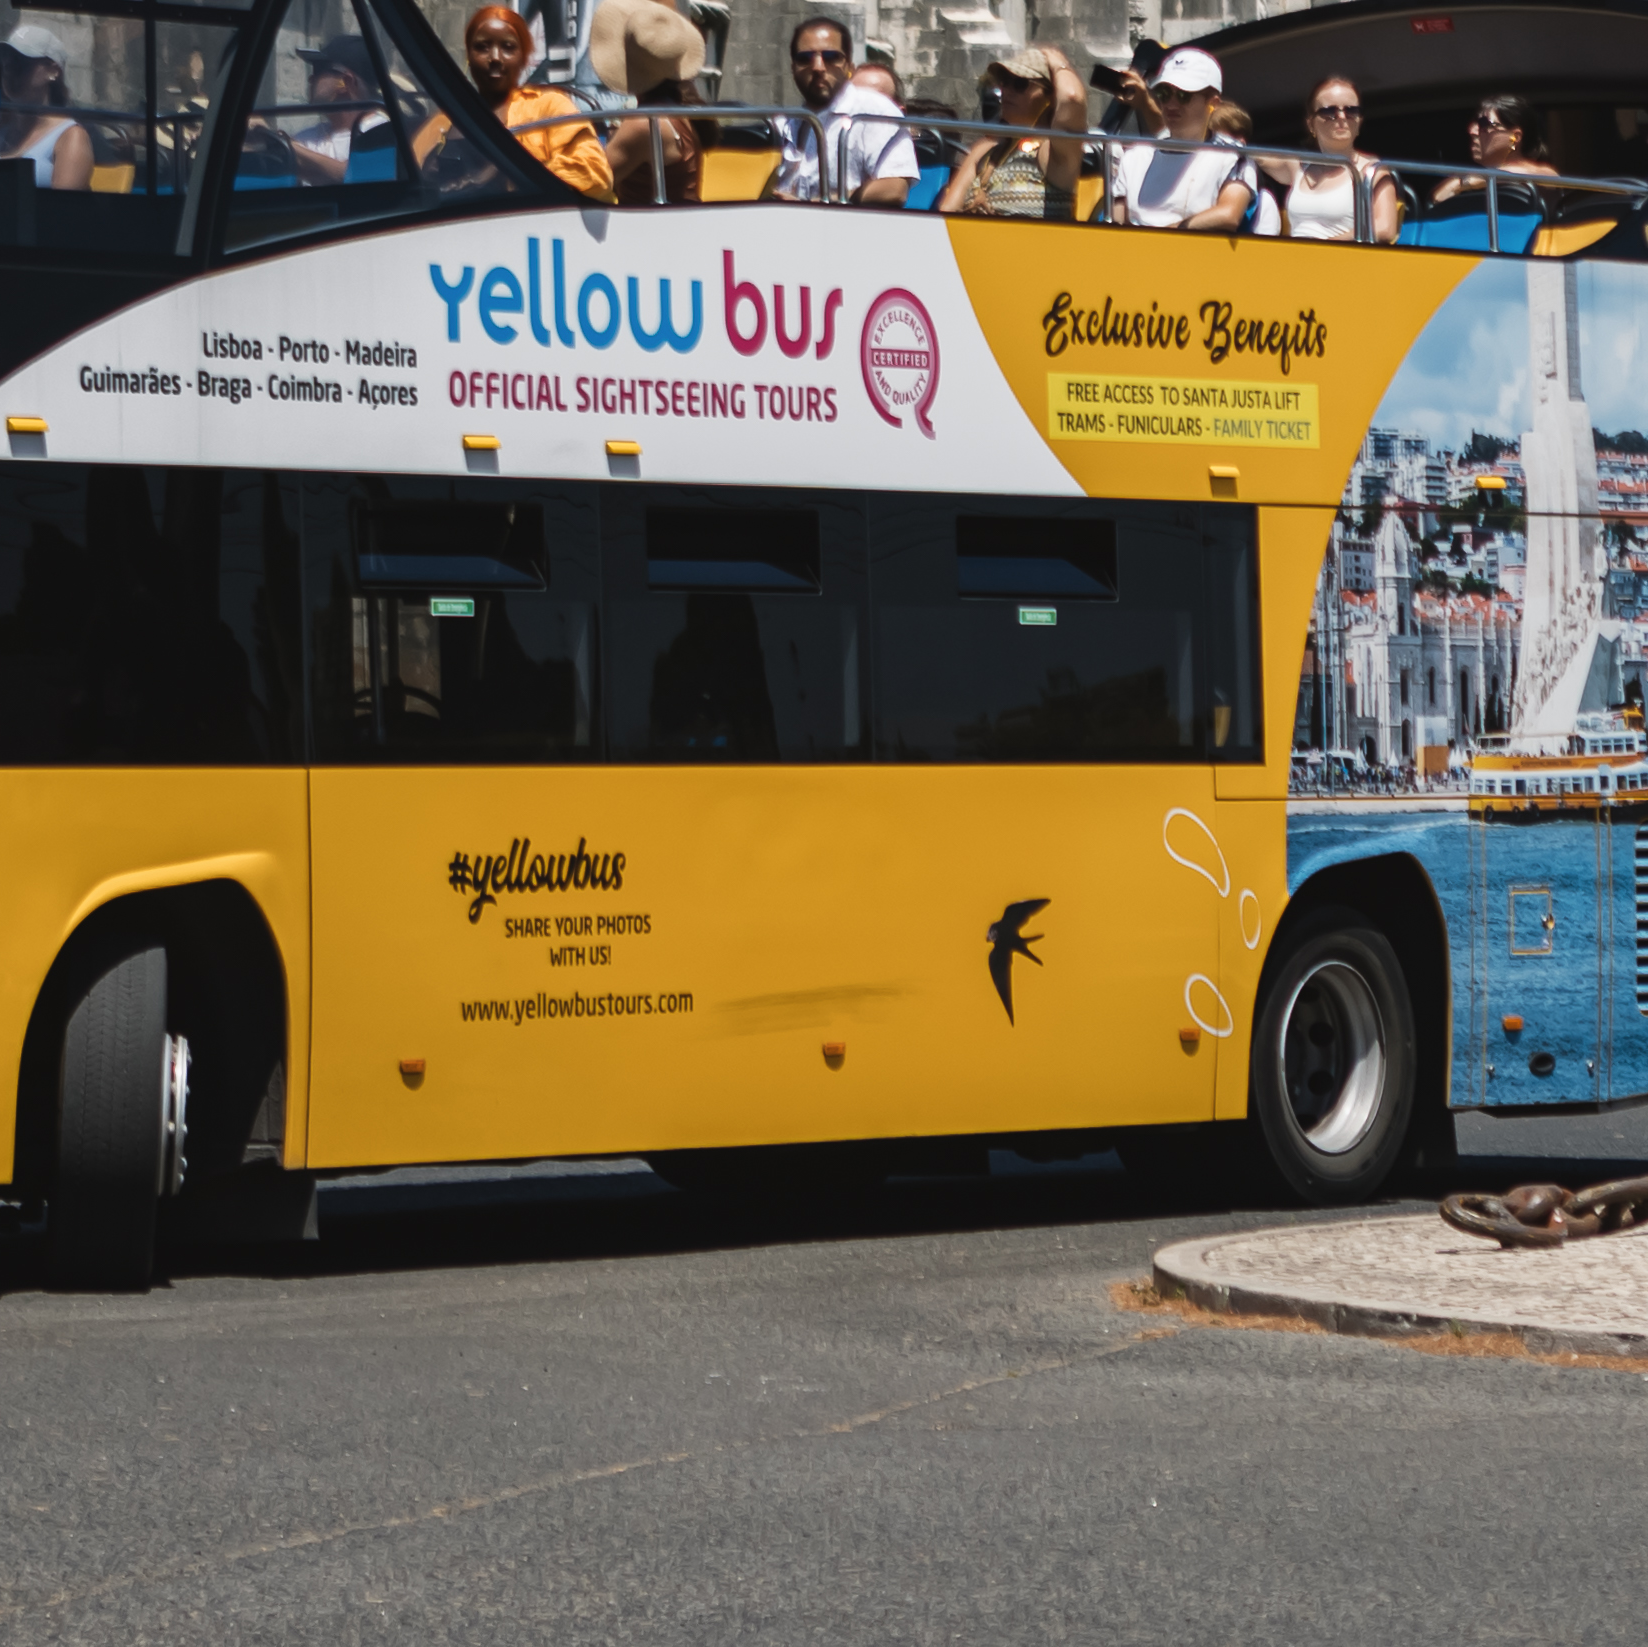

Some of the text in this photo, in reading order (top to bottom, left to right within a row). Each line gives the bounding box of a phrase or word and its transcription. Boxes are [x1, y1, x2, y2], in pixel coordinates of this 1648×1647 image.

[429, 236, 843, 361] yellow bus
[873, 309, 926, 346] EXCELLENCE
[1042, 291, 1328, 376] Exclusive Benefits
[202, 330, 263, 361] Lisboa
[279, 335, 330, 364] Porto
[345, 339, 418, 369] Madeira
[873, 352, 928, 367] CERTIFIED
[79, 364, 182, 397] Guimarães
[197, 369, 252, 404] Braga
[268, 373, 343, 404] Coimbra
[359, 378, 418, 410] Açores
[449, 370, 838, 423] OFFICIAL SIGHTSEEING TOURS
[875, 370, 927, 406] AND QUALITY
[1067, 382, 1301, 411] FREE ACCESS TO SANTA JUSTA LIFT
[1057, 412, 1106, 434] TRAMS
[1117, 414, 1202, 437] FUNICULARS
[1214, 418, 1263, 439] FAMILY
[1266, 420, 1312, 441] TICKET
[448, 837, 626, 925] #yellowbus
[505, 914, 652, 938] SHARE YOUR PHOTOS
[550, 945, 612, 967] WITH US!
[461, 991, 694, 1026] www.yellowbustours.com
